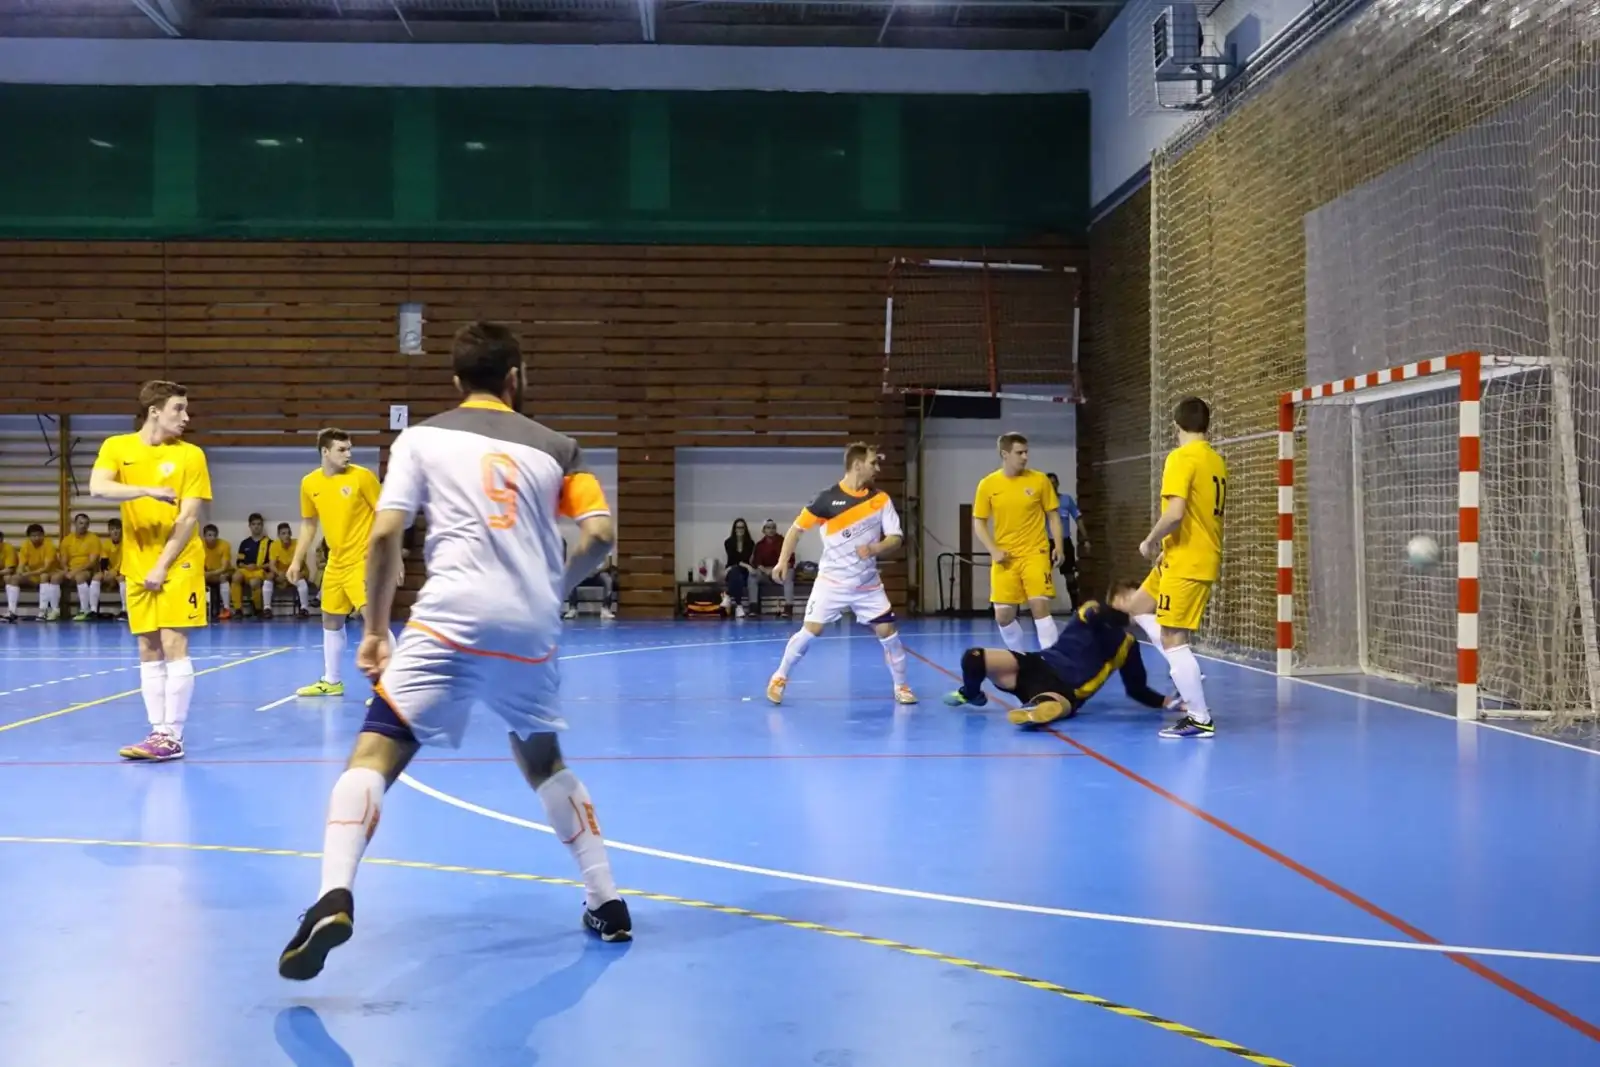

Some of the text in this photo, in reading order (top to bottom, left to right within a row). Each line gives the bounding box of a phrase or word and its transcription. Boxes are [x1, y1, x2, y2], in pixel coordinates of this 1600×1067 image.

[481, 452, 518, 529] 9
[1212, 475, 1227, 517] 11
[188, 591, 198, 609] 4
[1158, 594, 1171, 611] 11
